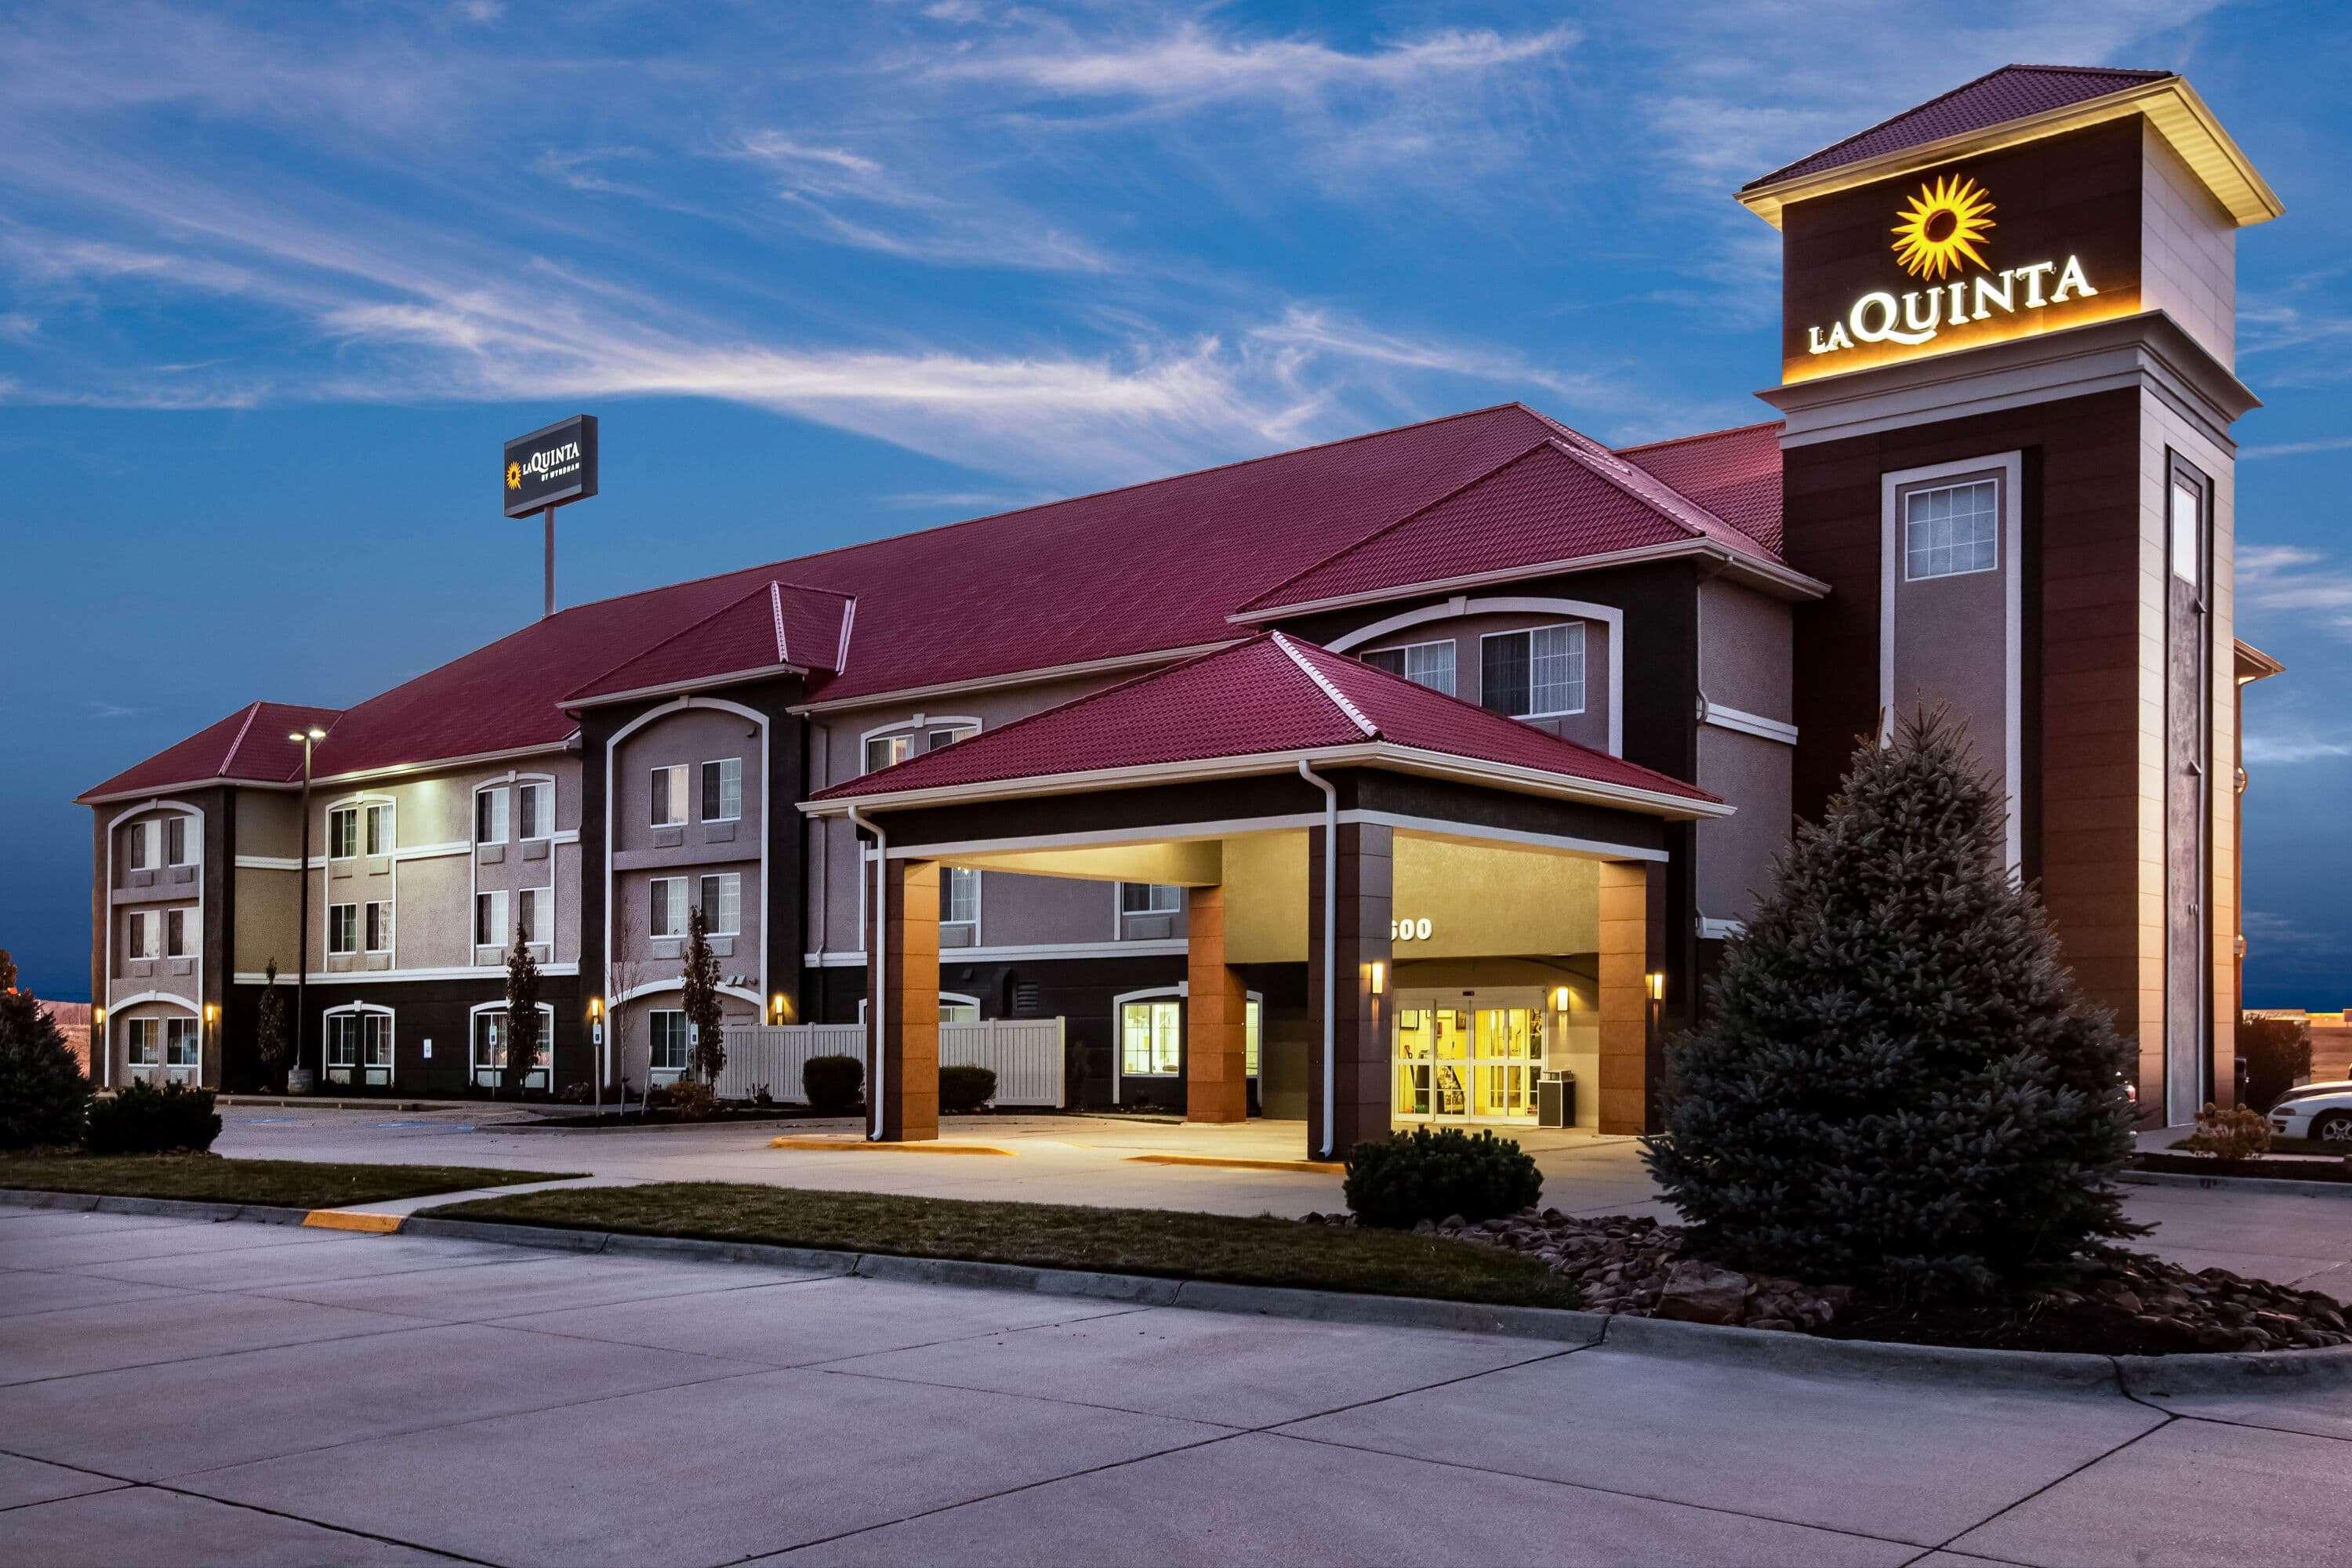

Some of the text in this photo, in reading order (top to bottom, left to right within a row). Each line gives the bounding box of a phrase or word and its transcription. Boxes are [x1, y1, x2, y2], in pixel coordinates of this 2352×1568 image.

[1808, 255, 2099, 354] LA QUINTA
[522, 441, 579, 475] LA QUINTA
[541, 473, 549, 481] BY
